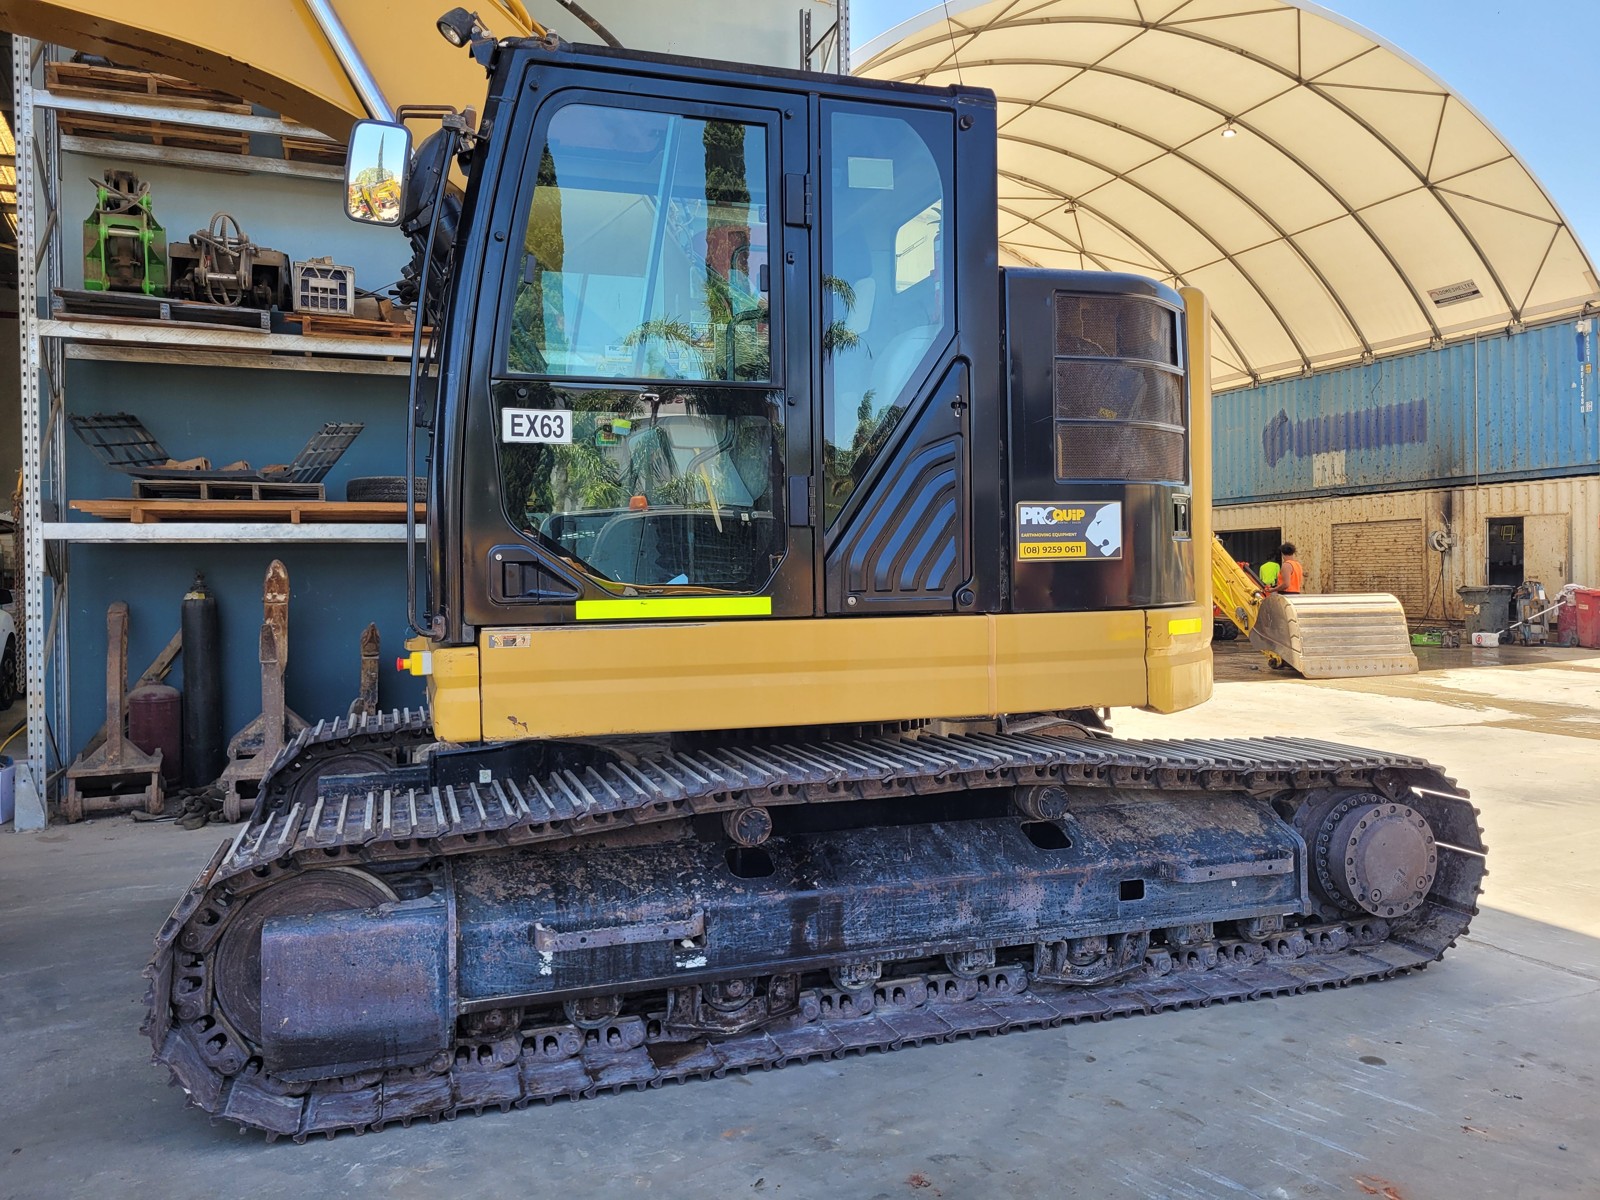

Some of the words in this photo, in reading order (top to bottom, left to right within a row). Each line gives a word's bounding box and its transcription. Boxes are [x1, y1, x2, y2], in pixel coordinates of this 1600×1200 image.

[511, 414, 564, 438] EX63
[1023, 545, 1040, 555] (08)
[1042, 545, 1063, 554] 9259
[1064, 545, 1082, 553] 0611
